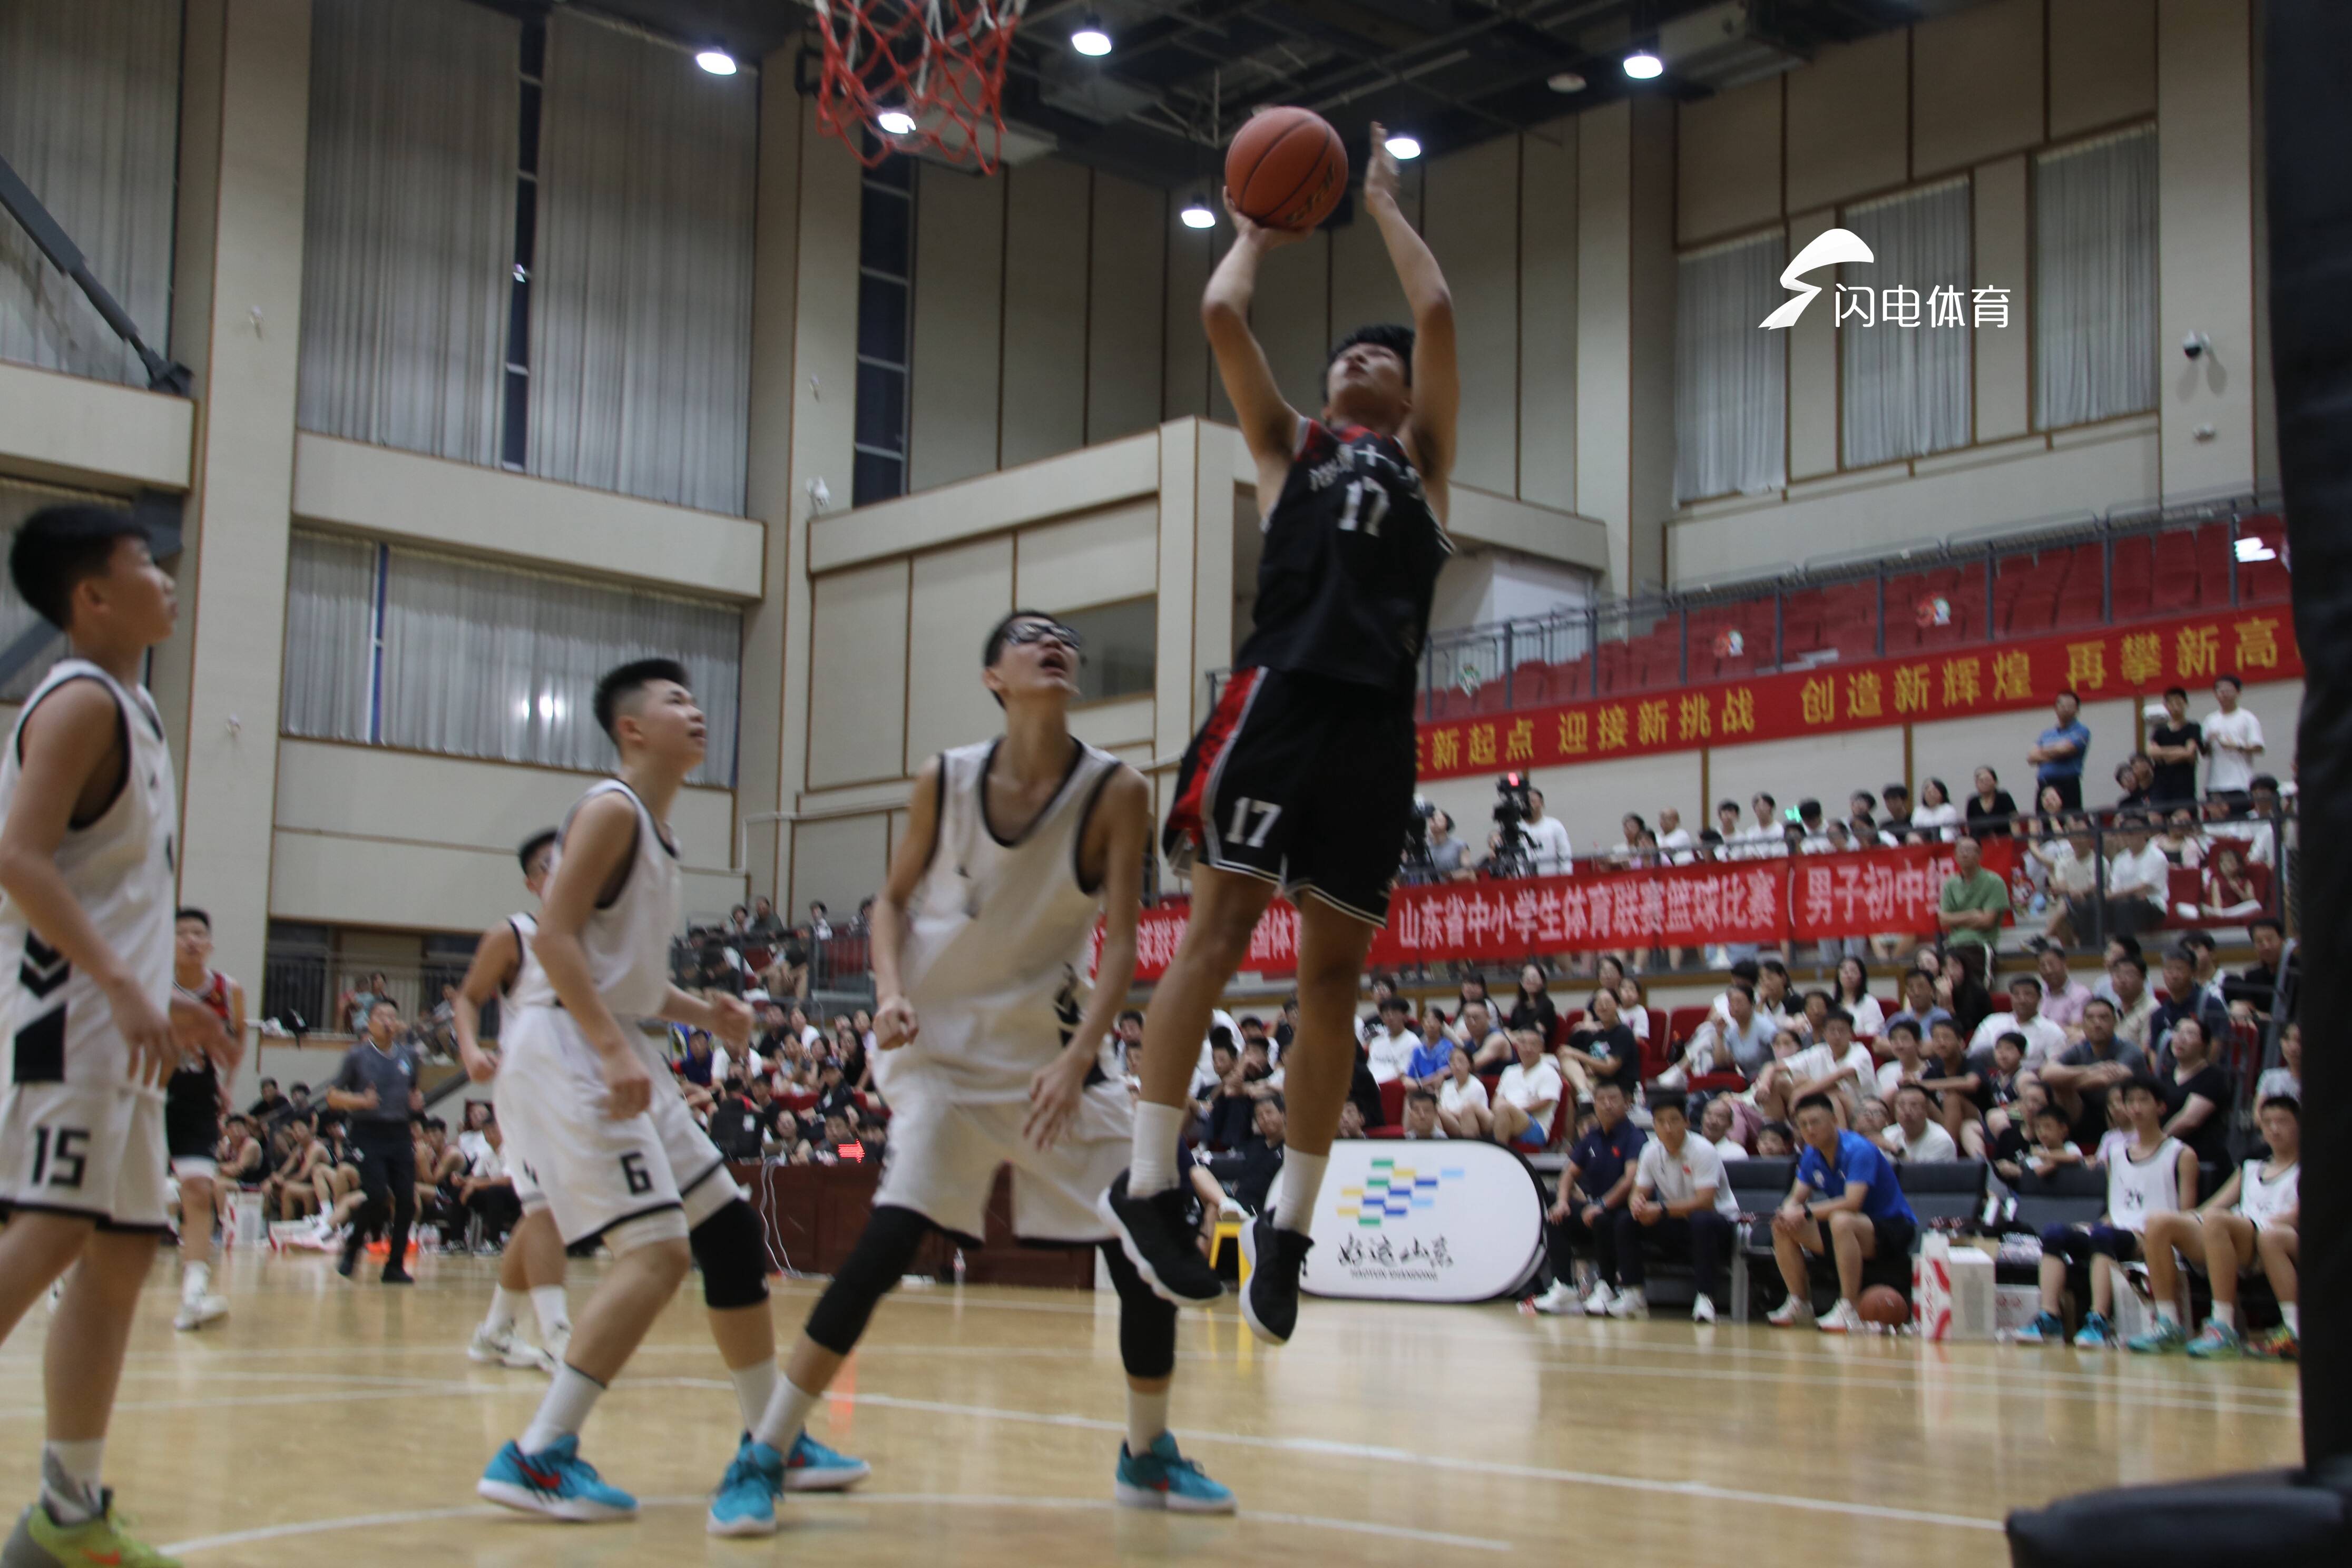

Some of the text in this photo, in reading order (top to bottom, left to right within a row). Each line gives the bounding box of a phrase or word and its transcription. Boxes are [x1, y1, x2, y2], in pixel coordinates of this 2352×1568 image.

[1337, 475, 1391, 537] 17
[1557, 687, 1756, 755] 迎接新挑战
[1800, 649, 2033, 725] 创造新辉煌
[2066, 615, 2300, 691] 再攀新高
[1225, 796, 1282, 848] 17
[31, 1125, 91, 1188] 15
[620, 1151, 653, 1195] 6
